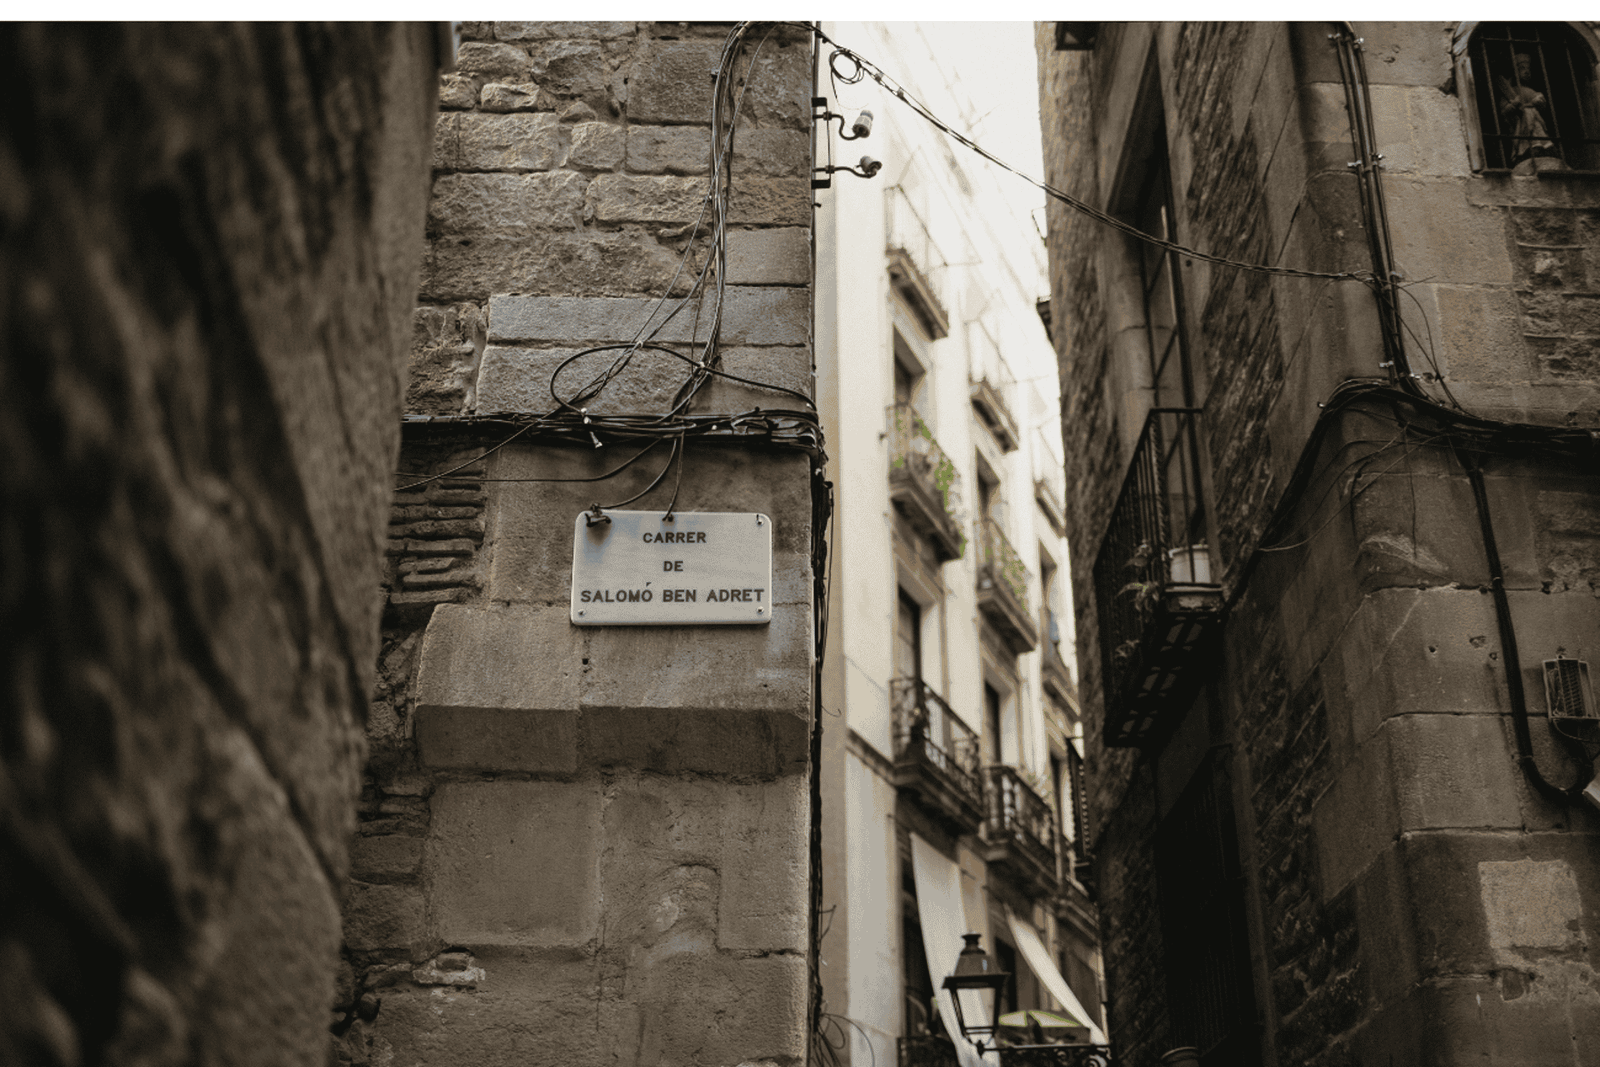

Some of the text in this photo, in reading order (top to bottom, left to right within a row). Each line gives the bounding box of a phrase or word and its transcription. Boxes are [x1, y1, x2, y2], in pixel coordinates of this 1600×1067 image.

[642, 531, 707, 544] CARRER
[663, 560, 684, 572] DE
[580, 581, 765, 603] SALOMÓ BEN ADRET
